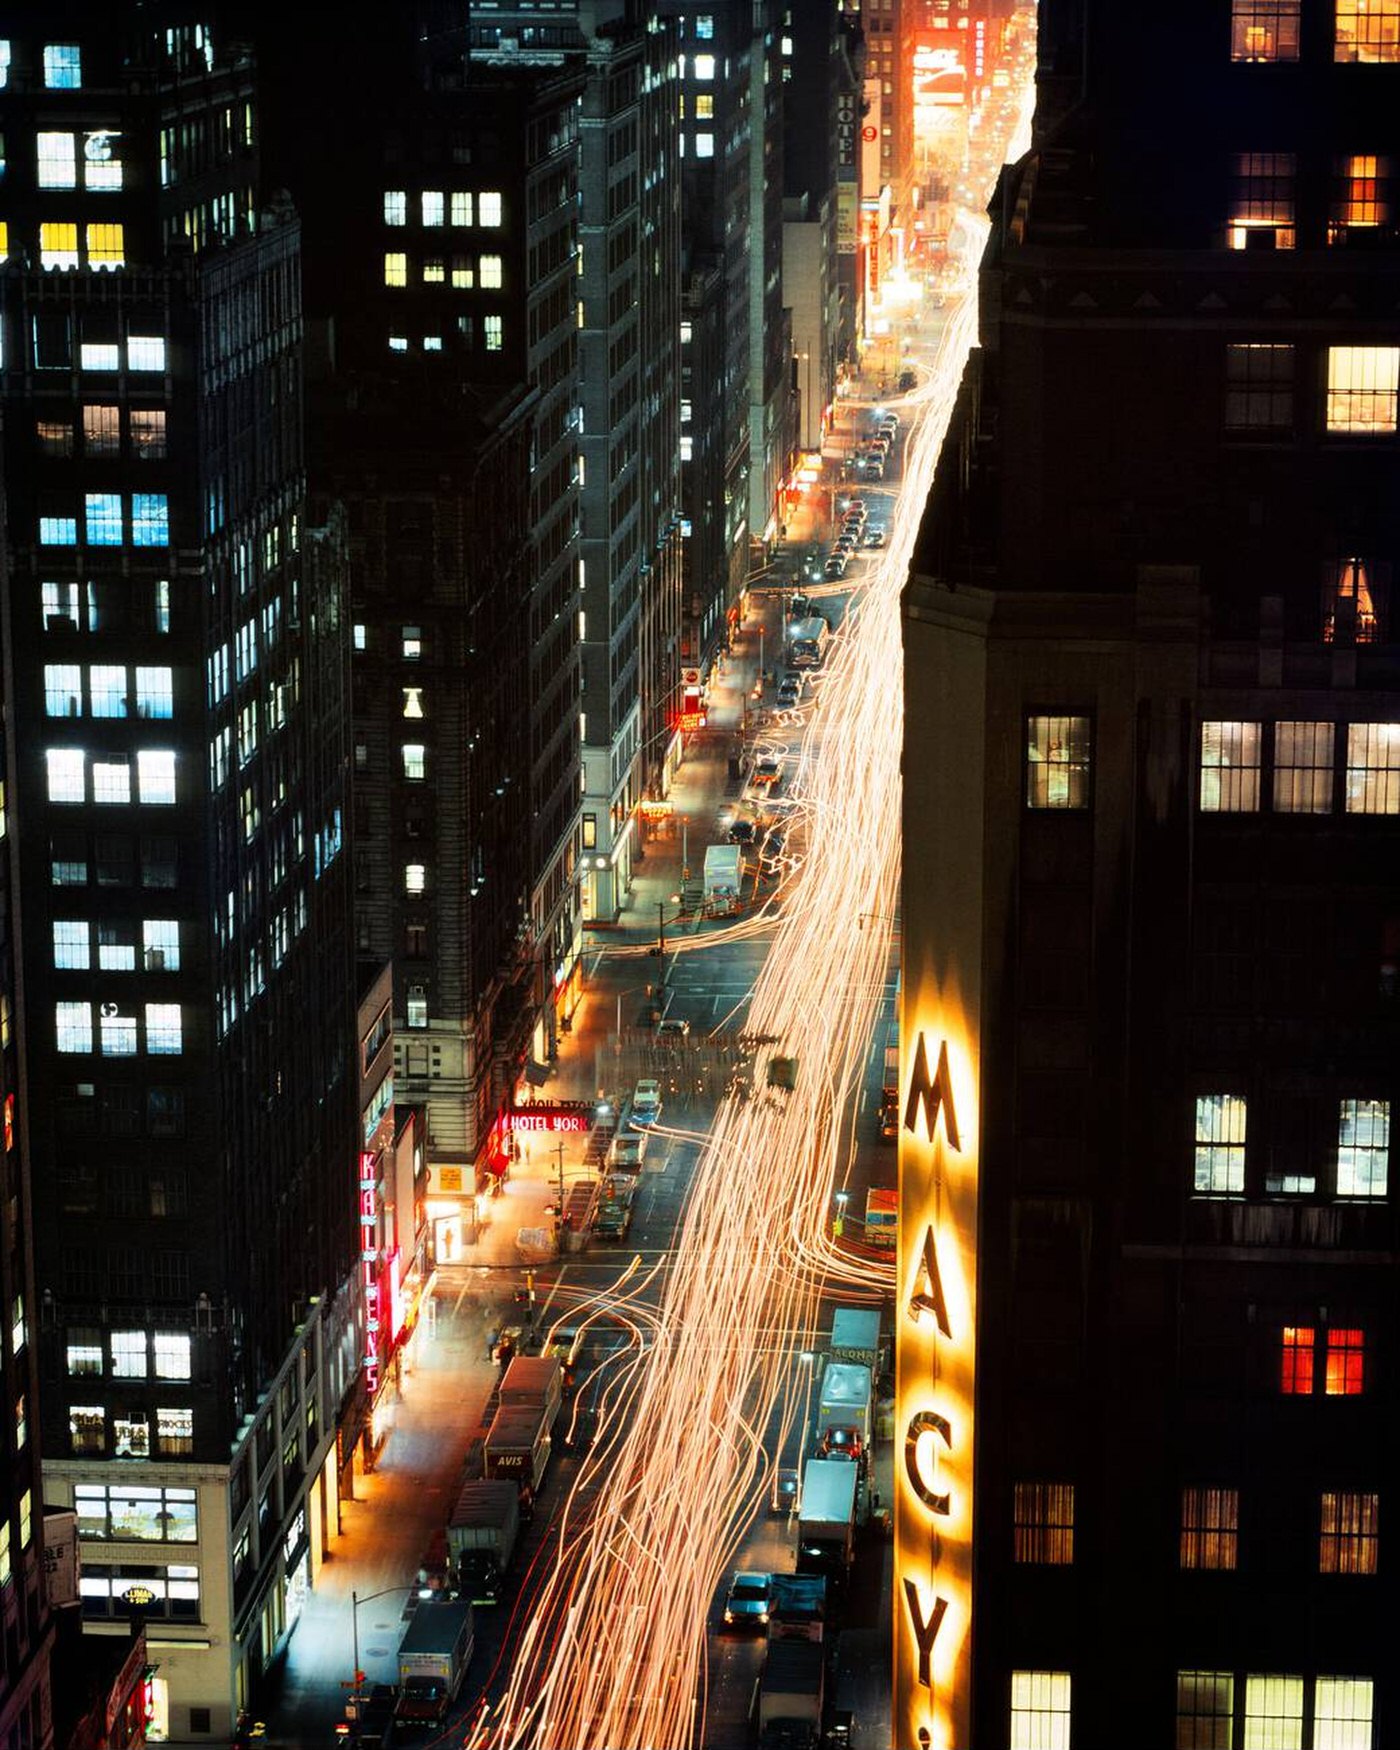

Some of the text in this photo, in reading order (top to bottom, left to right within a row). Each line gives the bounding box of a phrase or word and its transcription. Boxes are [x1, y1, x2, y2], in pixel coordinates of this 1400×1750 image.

[838, 95, 854, 165] HOTEL
[861, 125, 877, 143] 9
[511, 1115, 588, 1132] HOTEL YORK
[497, 1456, 524, 1466] AVIS
